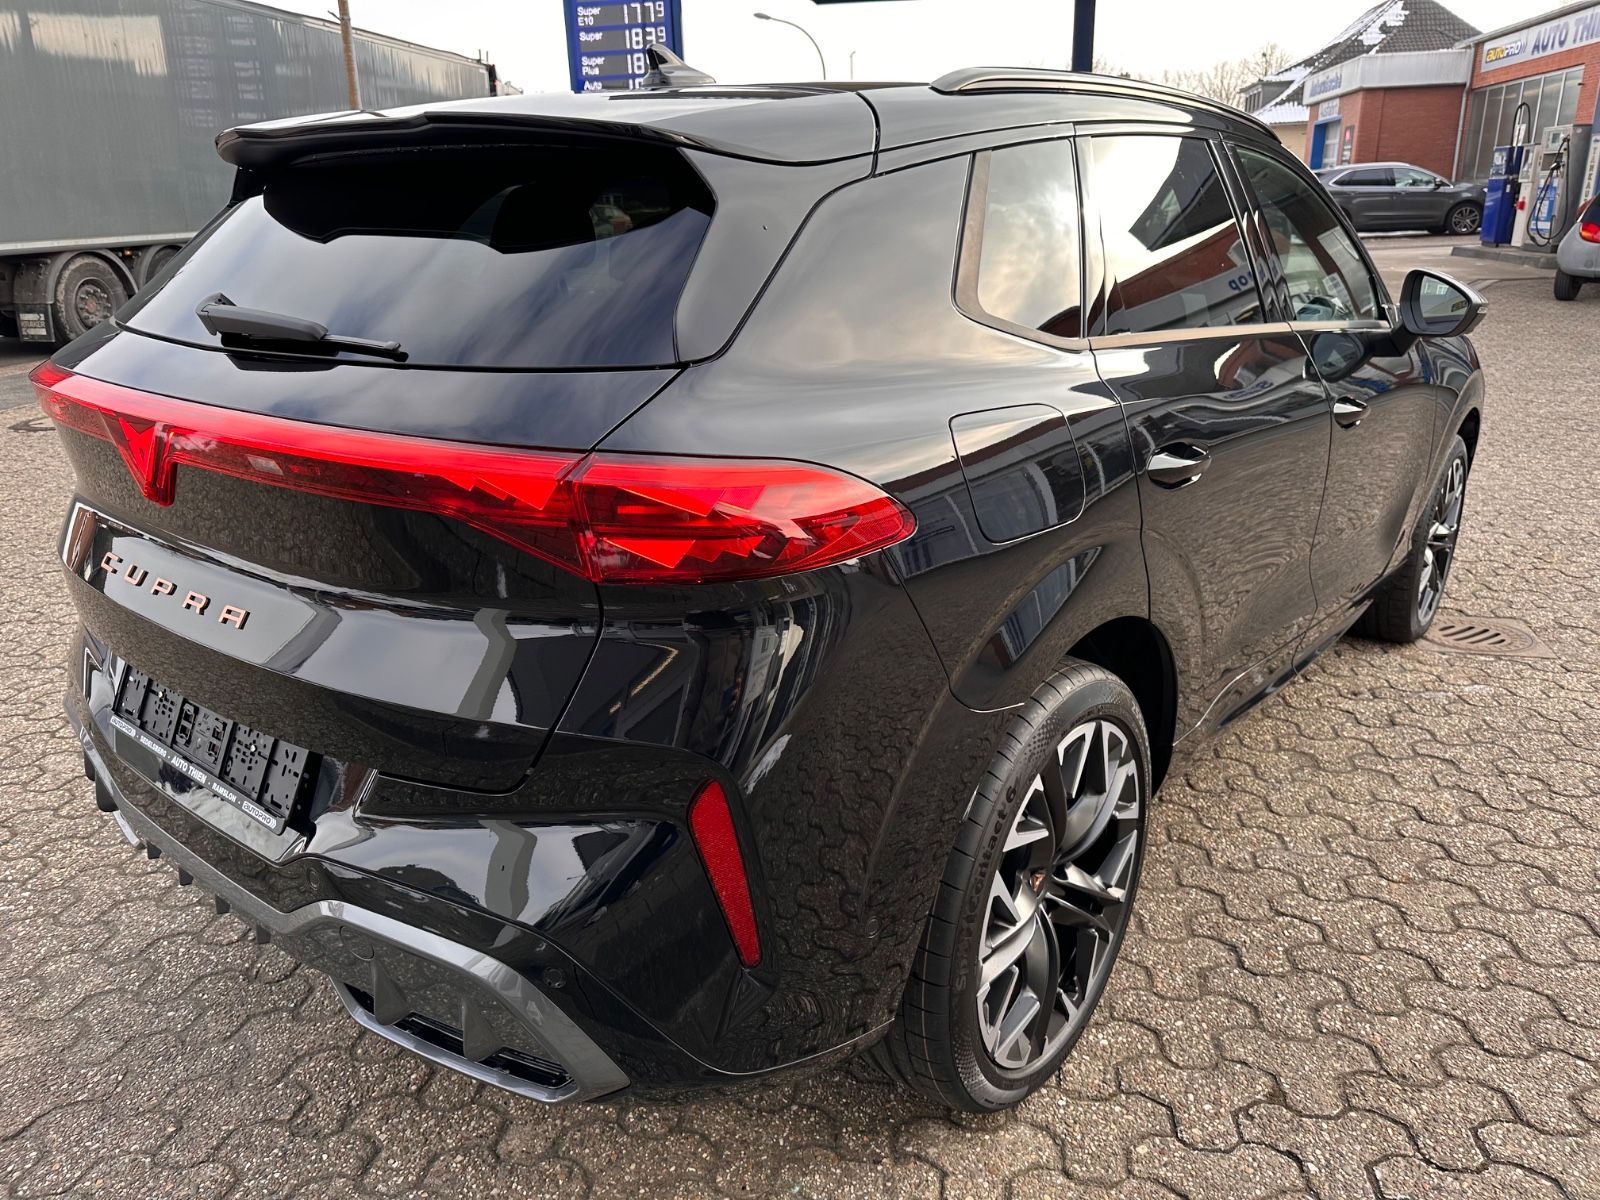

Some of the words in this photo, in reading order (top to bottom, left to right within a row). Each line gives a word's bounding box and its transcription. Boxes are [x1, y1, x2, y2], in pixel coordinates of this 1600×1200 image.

[577, 6, 601, 16] Super
[577, 17, 594, 26] E10
[579, 32, 603, 41] Super
[1531, 21, 1569, 55] AUTO
[581, 56, 605, 66] Super
[582, 67, 600, 76] Plus
[101, 551, 250, 630] CUPRA
[171, 756, 188, 771] AUTO
[187, 765, 208, 784] THIEN
